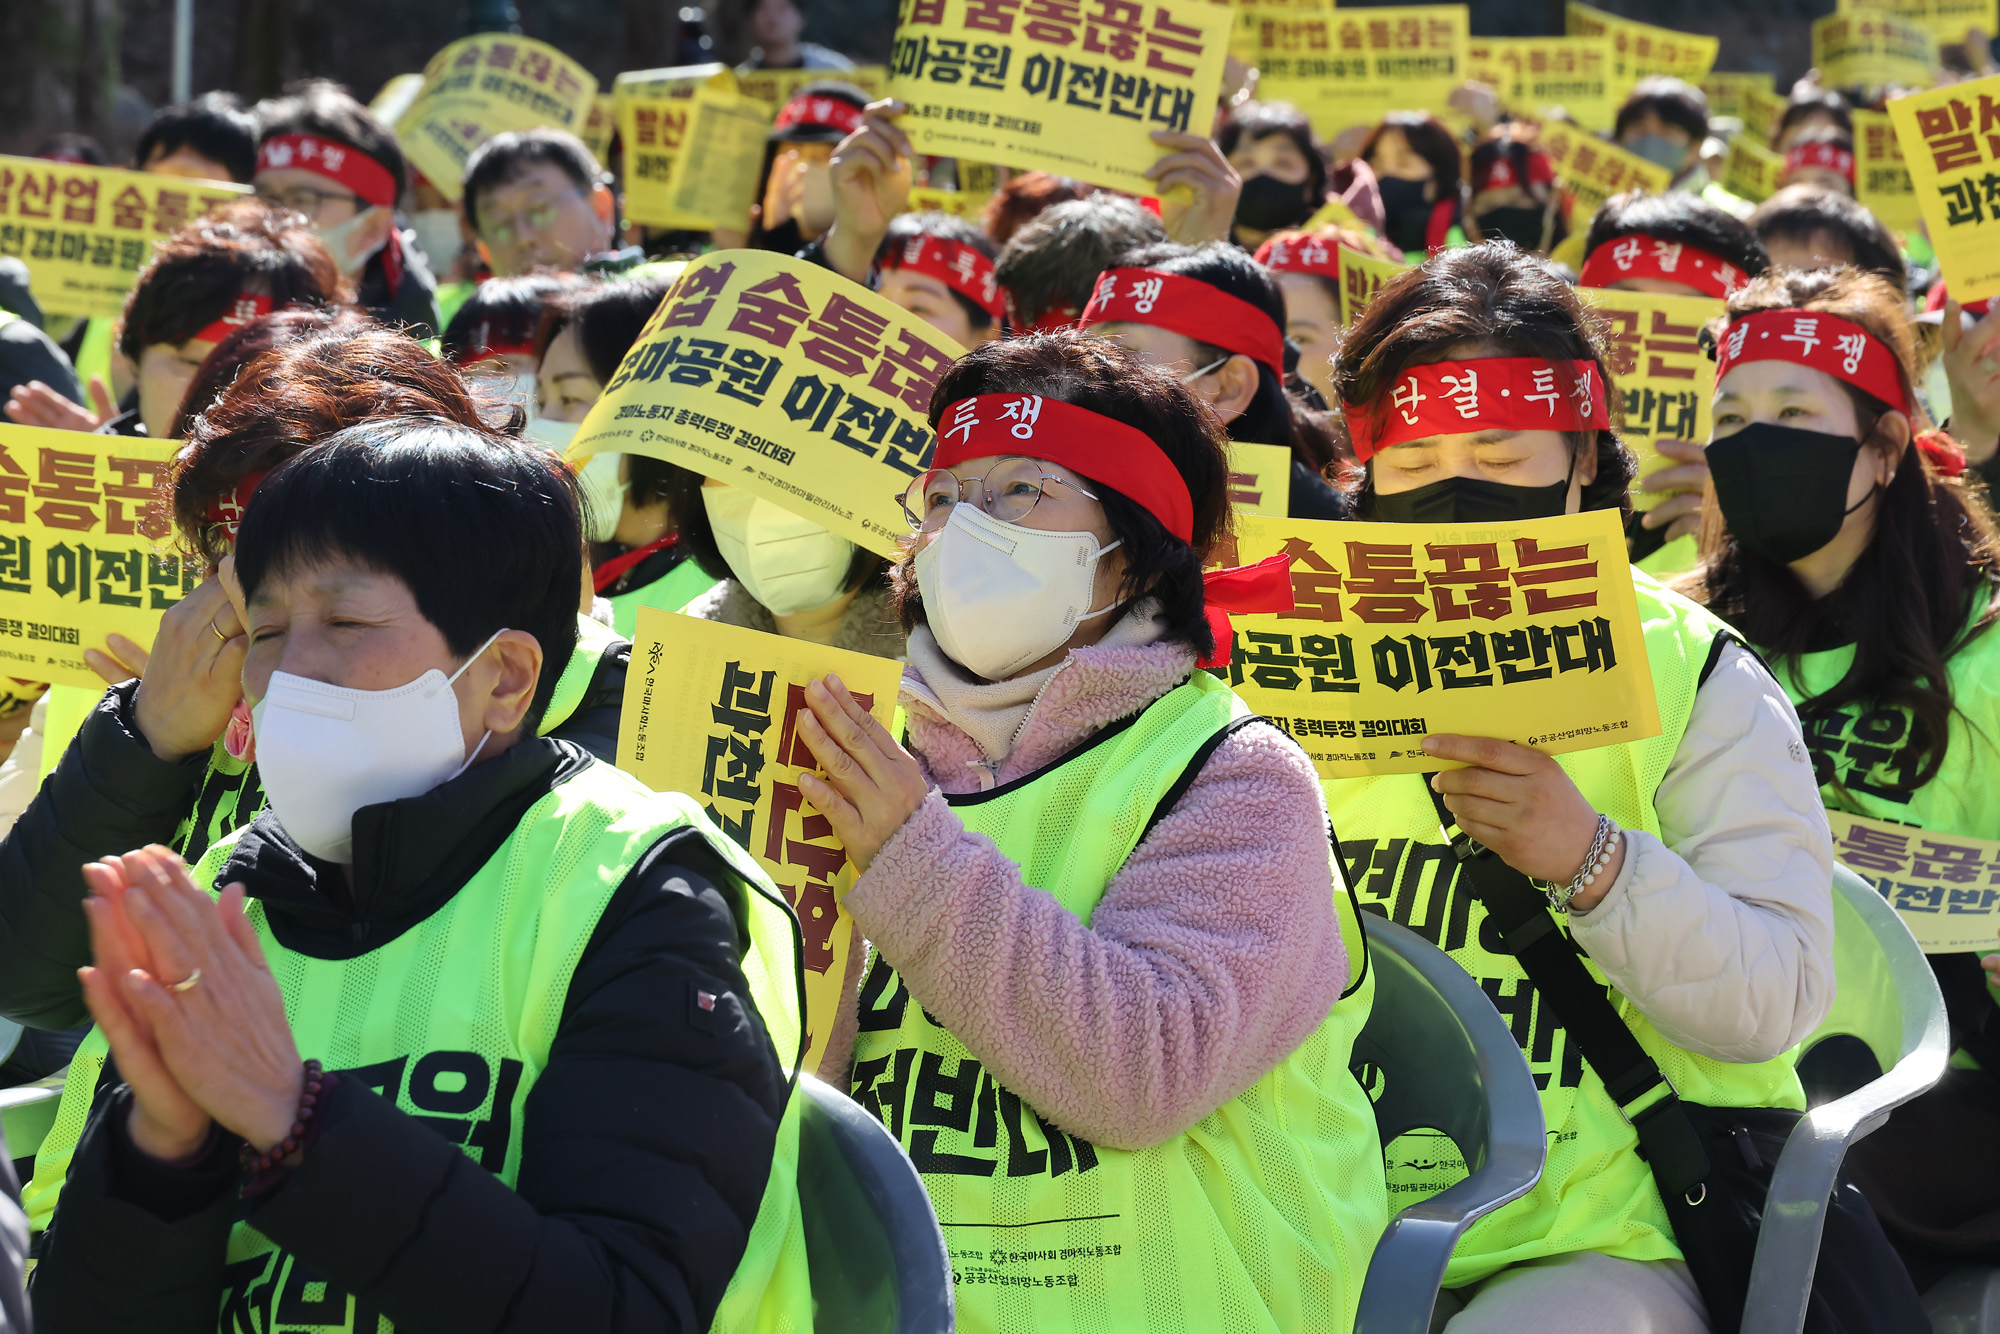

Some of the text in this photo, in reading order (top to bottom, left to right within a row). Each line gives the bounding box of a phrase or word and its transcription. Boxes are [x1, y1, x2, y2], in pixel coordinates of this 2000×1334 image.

[890, 36, 1012, 90] 마공원
[1716, 317, 1867, 375] 결·투쟁
[674, 408, 735, 441] 총력투쟁
[733, 428, 797, 467] 결의대회
[944, 394, 1043, 446] 투쟁
[27, 621, 80, 646] 결의대회
[1370, 615, 1618, 694] 이전반대
[1293, 718, 1357, 739] 총력투쟁
[1360, 716, 1428, 737] 결의대회
[1538, 719, 1630, 744] 공공산업희망노동조합
[1009, 1251, 1058, 1264] 한국마사회
[1060, 1244, 1122, 1260] 경마직노동조합
[964, 1272, 1079, 1289] 공공산업희망노동조합
